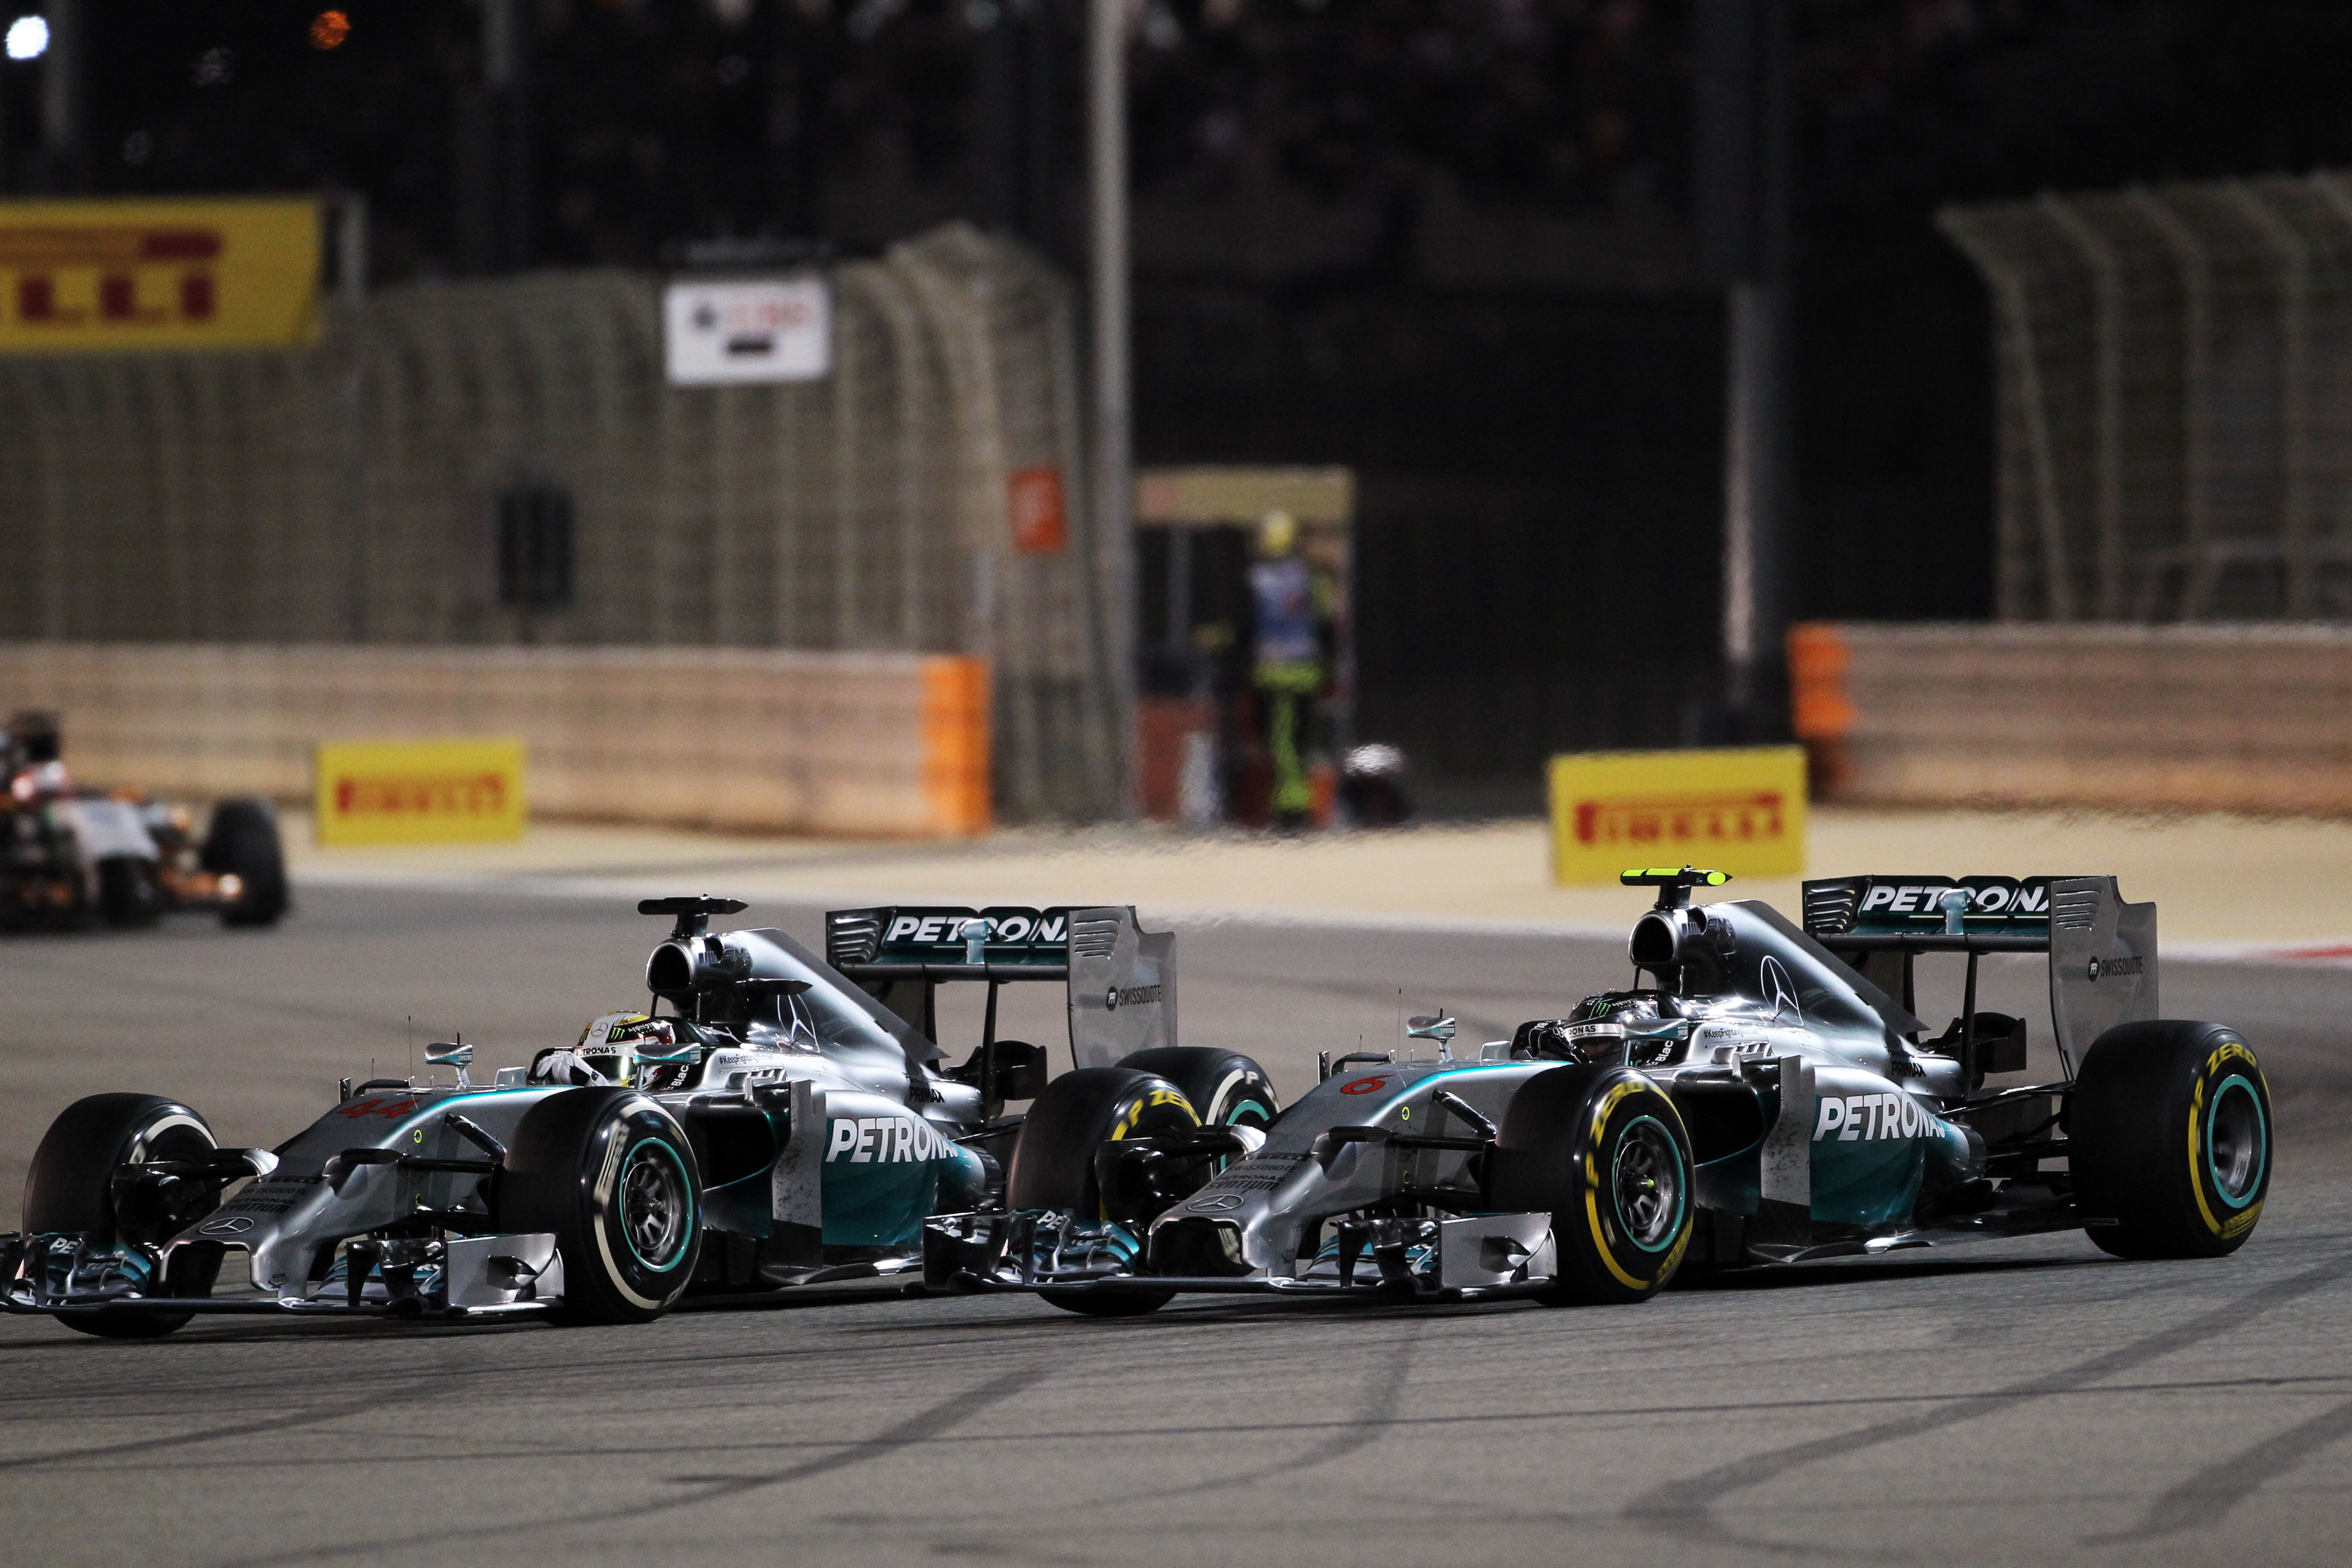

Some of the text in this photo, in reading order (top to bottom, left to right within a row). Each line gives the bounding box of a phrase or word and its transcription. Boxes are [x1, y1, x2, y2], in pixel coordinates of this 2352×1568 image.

[1862, 886, 2049, 911] PETON
[886, 916, 1067, 942] PETON
[2100, 956, 2143, 978] SWISSQUOTE
[1119, 984, 1162, 1006] SWISSQUOTE
[1654, 1040, 1674, 1062] Blac
[670, 1064, 690, 1087] Blac
[1891, 1061, 1926, 1077] PRIMAX
[909, 1087, 945, 1103] PRIMAX
[1340, 1074, 1396, 1095] 6
[337, 1099, 419, 1118] 44
[1812, 1091, 1946, 1141] PETRONAS
